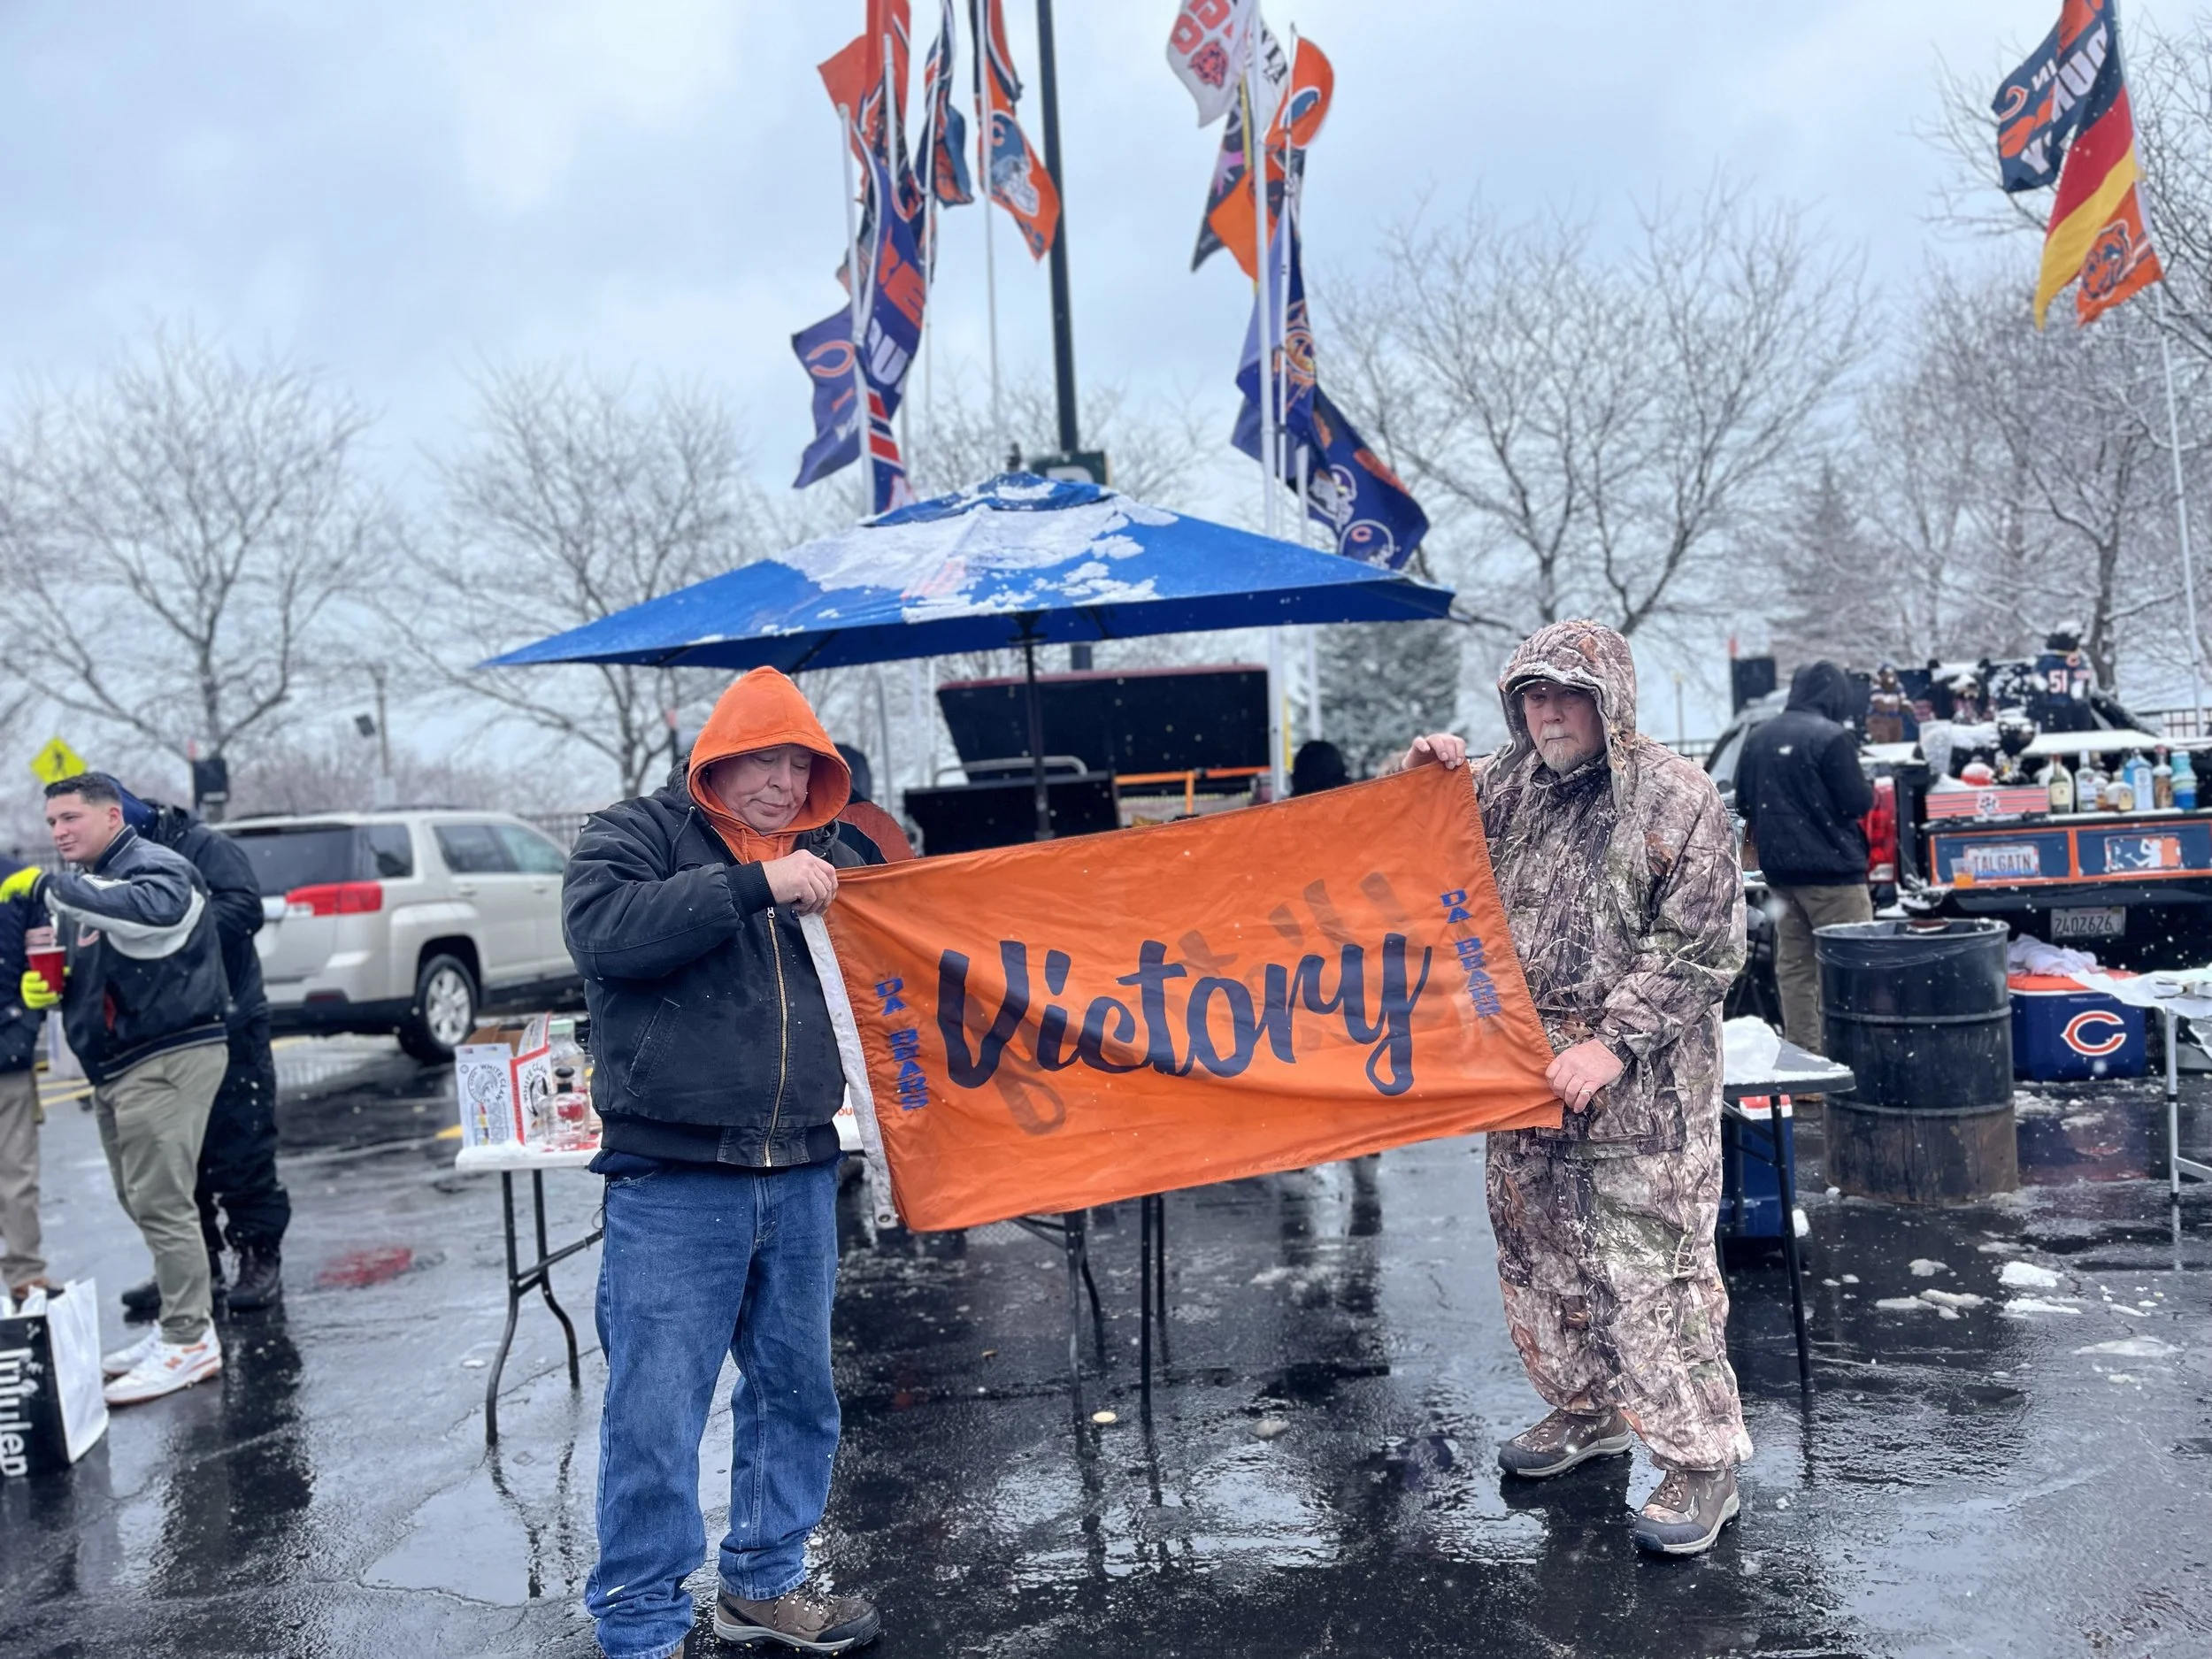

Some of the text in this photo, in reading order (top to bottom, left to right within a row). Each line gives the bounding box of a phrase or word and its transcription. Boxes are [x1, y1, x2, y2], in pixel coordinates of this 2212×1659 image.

[2048, 669, 2069, 695] 51
[937, 932, 1432, 1096] Victory
[480, 1064, 503, 1078] WHITE
[495, 1078, 507, 1102] CLAW
